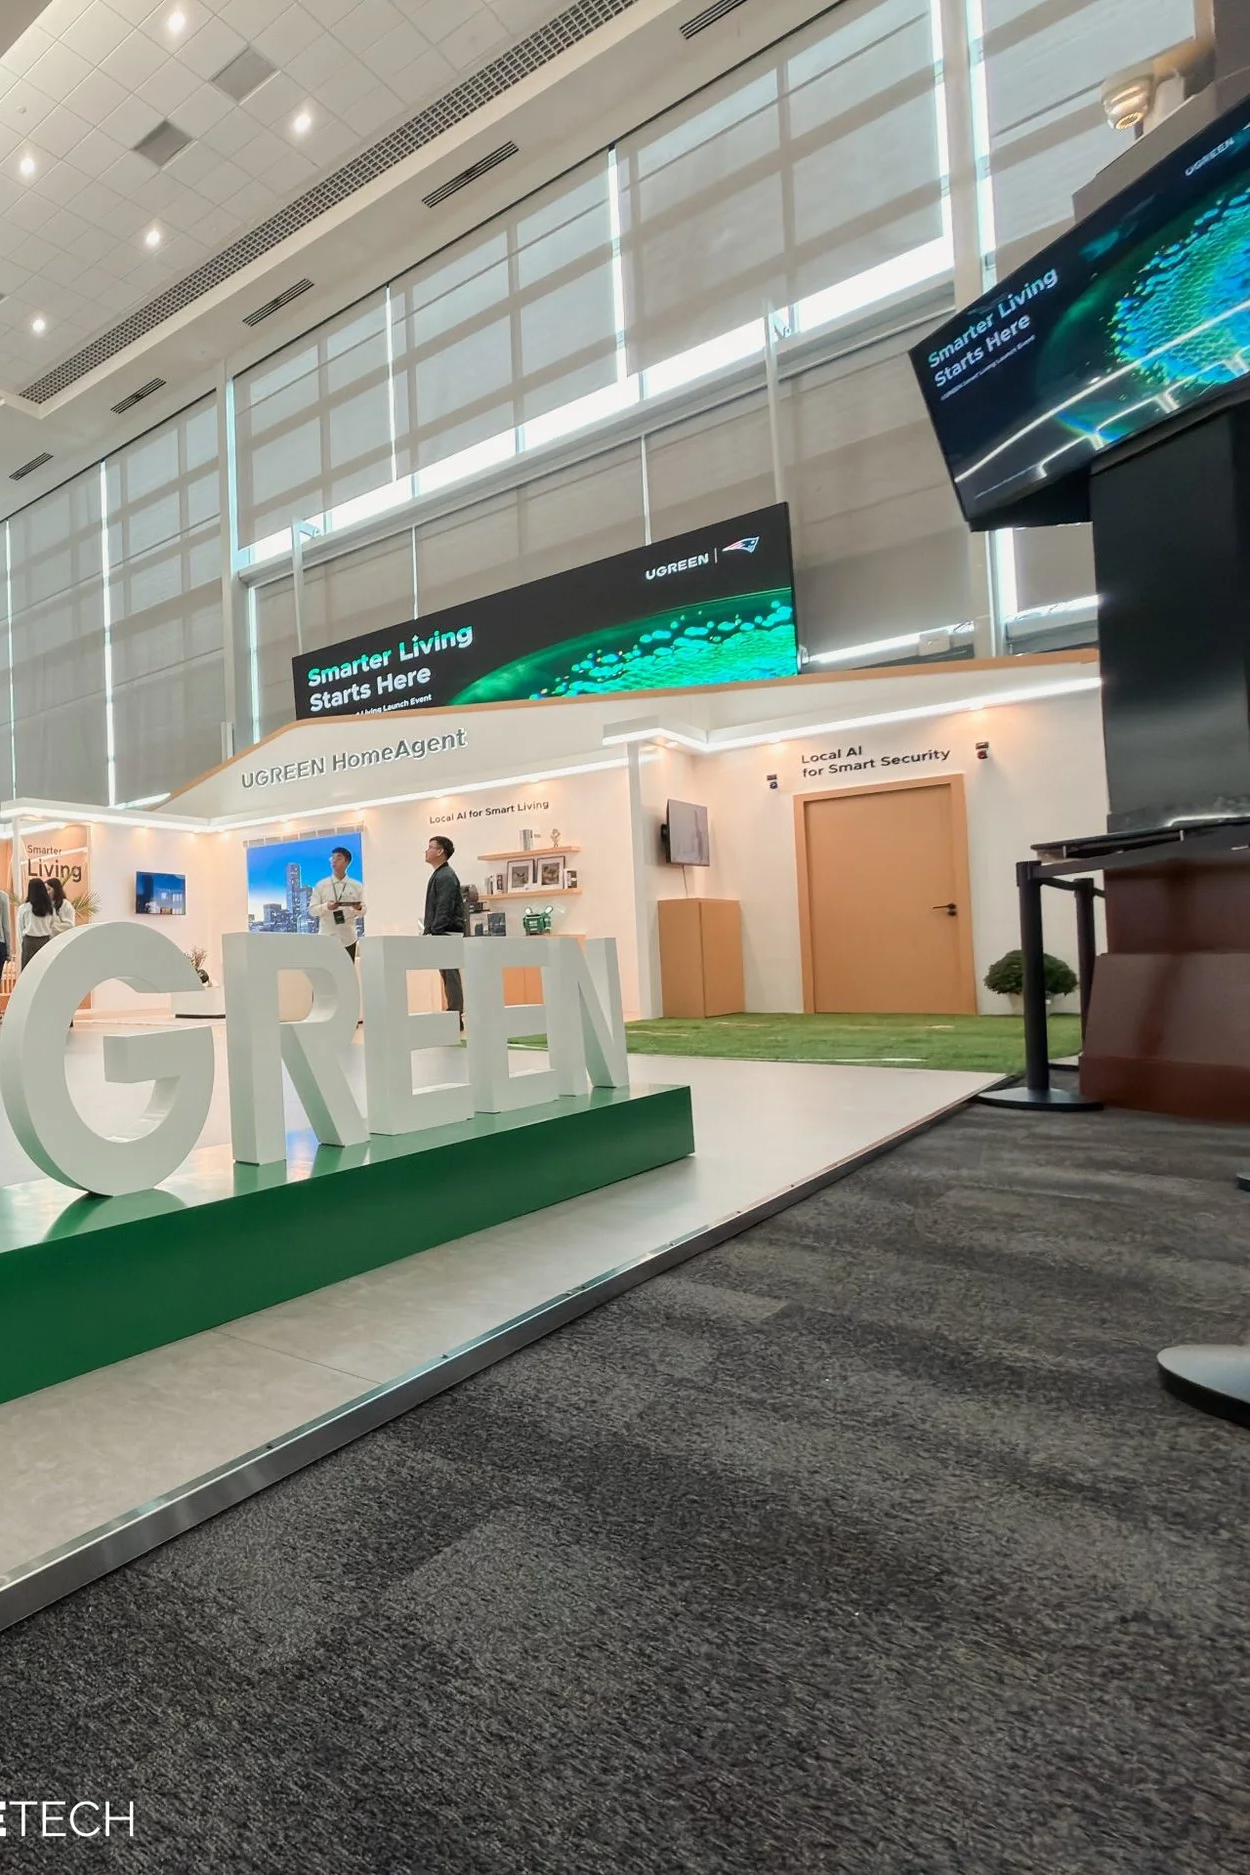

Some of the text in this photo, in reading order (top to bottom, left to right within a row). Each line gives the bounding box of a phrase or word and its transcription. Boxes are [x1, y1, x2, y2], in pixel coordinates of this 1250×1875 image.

[928, 313, 993, 368] Smarter
[998, 268, 1058, 318] Living
[934, 347, 985, 387] Starts
[985, 315, 1031, 352] Here
[645, 553, 709, 580] UGREEN
[308, 625, 473, 687] Smarter Living
[310, 667, 431, 712] Starts Here
[383, 700, 409, 712] Launch
[410, 693, 432, 706] Event
[241, 728, 468, 789] UGREEN HomeAgent
[801, 745, 862, 764] Local AI
[802, 749, 950, 778] for Smart Security
[429, 801, 549, 824] Local AI for Smart Living
[27, 844, 62, 856] Smarter
[28, 859, 82, 883] Living
